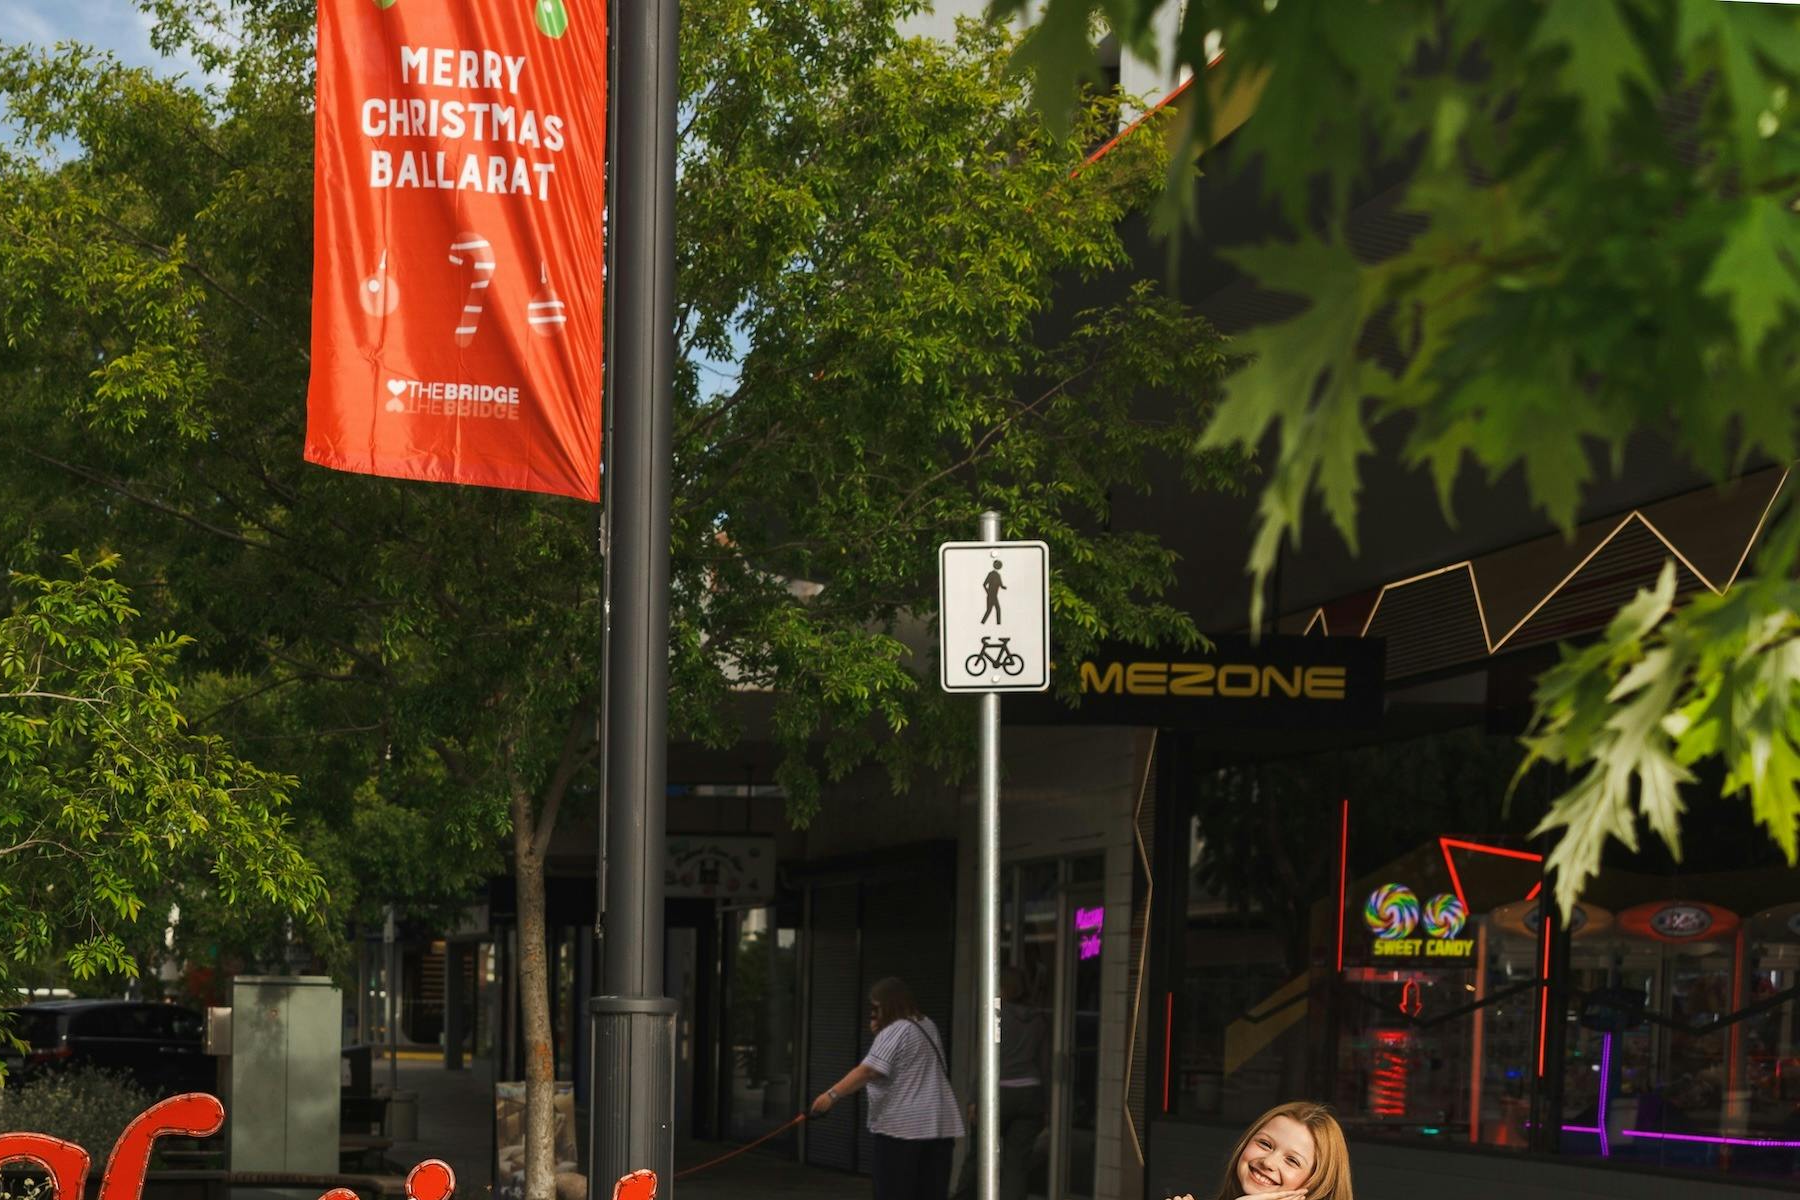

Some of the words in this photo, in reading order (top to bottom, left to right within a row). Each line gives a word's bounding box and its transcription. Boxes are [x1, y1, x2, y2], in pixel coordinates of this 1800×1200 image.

[401, 46, 525, 94] MERRY
[361, 98, 565, 152] CHRISTMAS
[369, 150, 555, 202] BALLARAT
[1080, 661, 1348, 700] MEZONE
[1373, 938, 1423, 957] SWEET
[1425, 938, 1475, 957] CANDY
